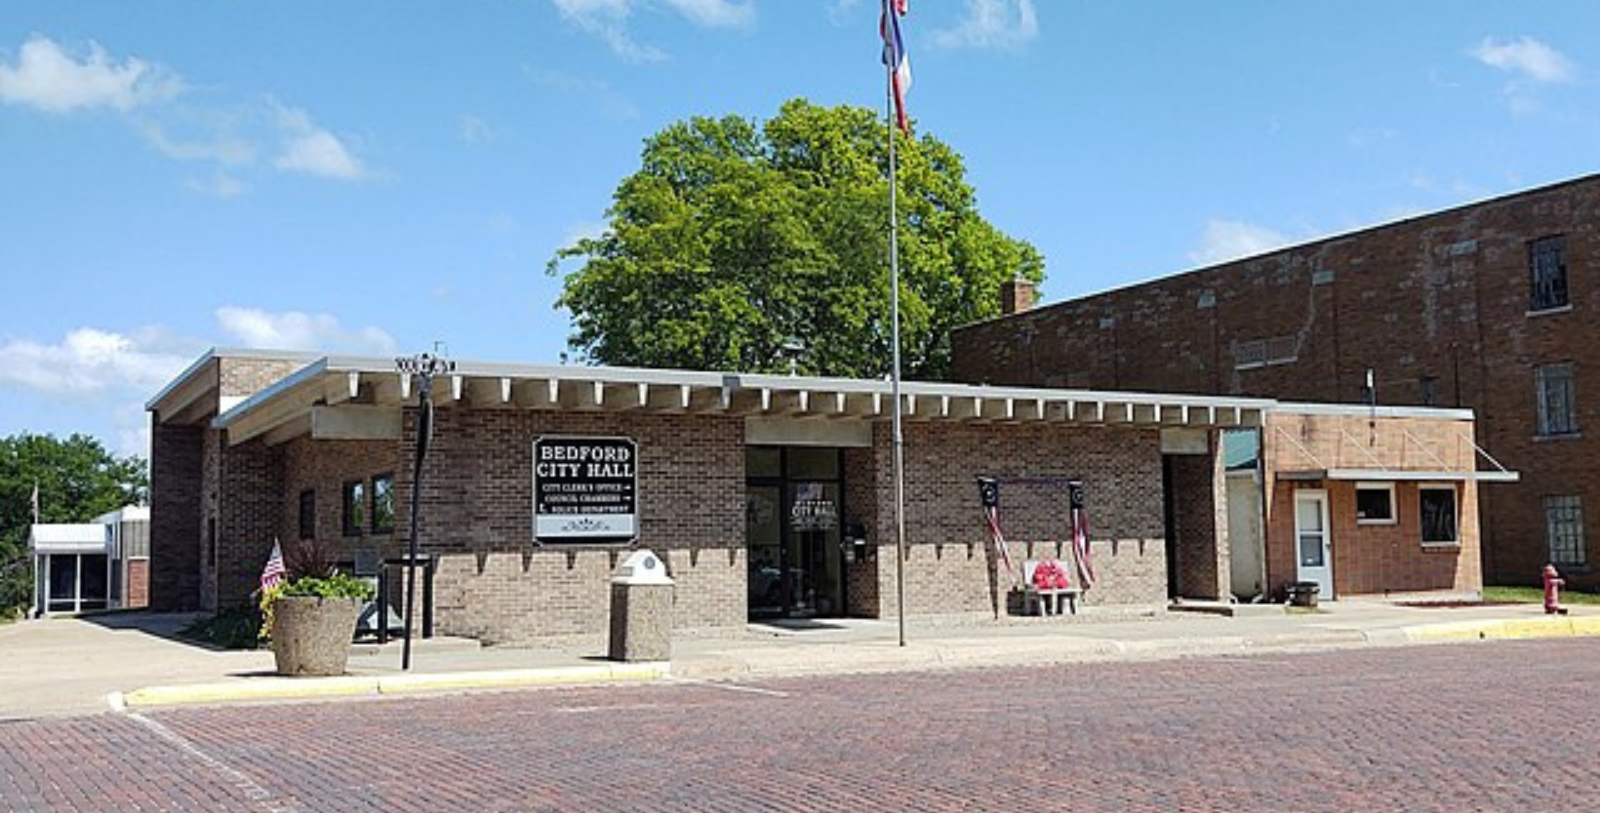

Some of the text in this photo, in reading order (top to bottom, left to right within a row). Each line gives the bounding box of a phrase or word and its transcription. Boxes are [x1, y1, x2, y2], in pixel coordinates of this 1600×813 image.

[541, 445, 630, 461] BEDFORD
[537, 463, 634, 477] CITY HALL
